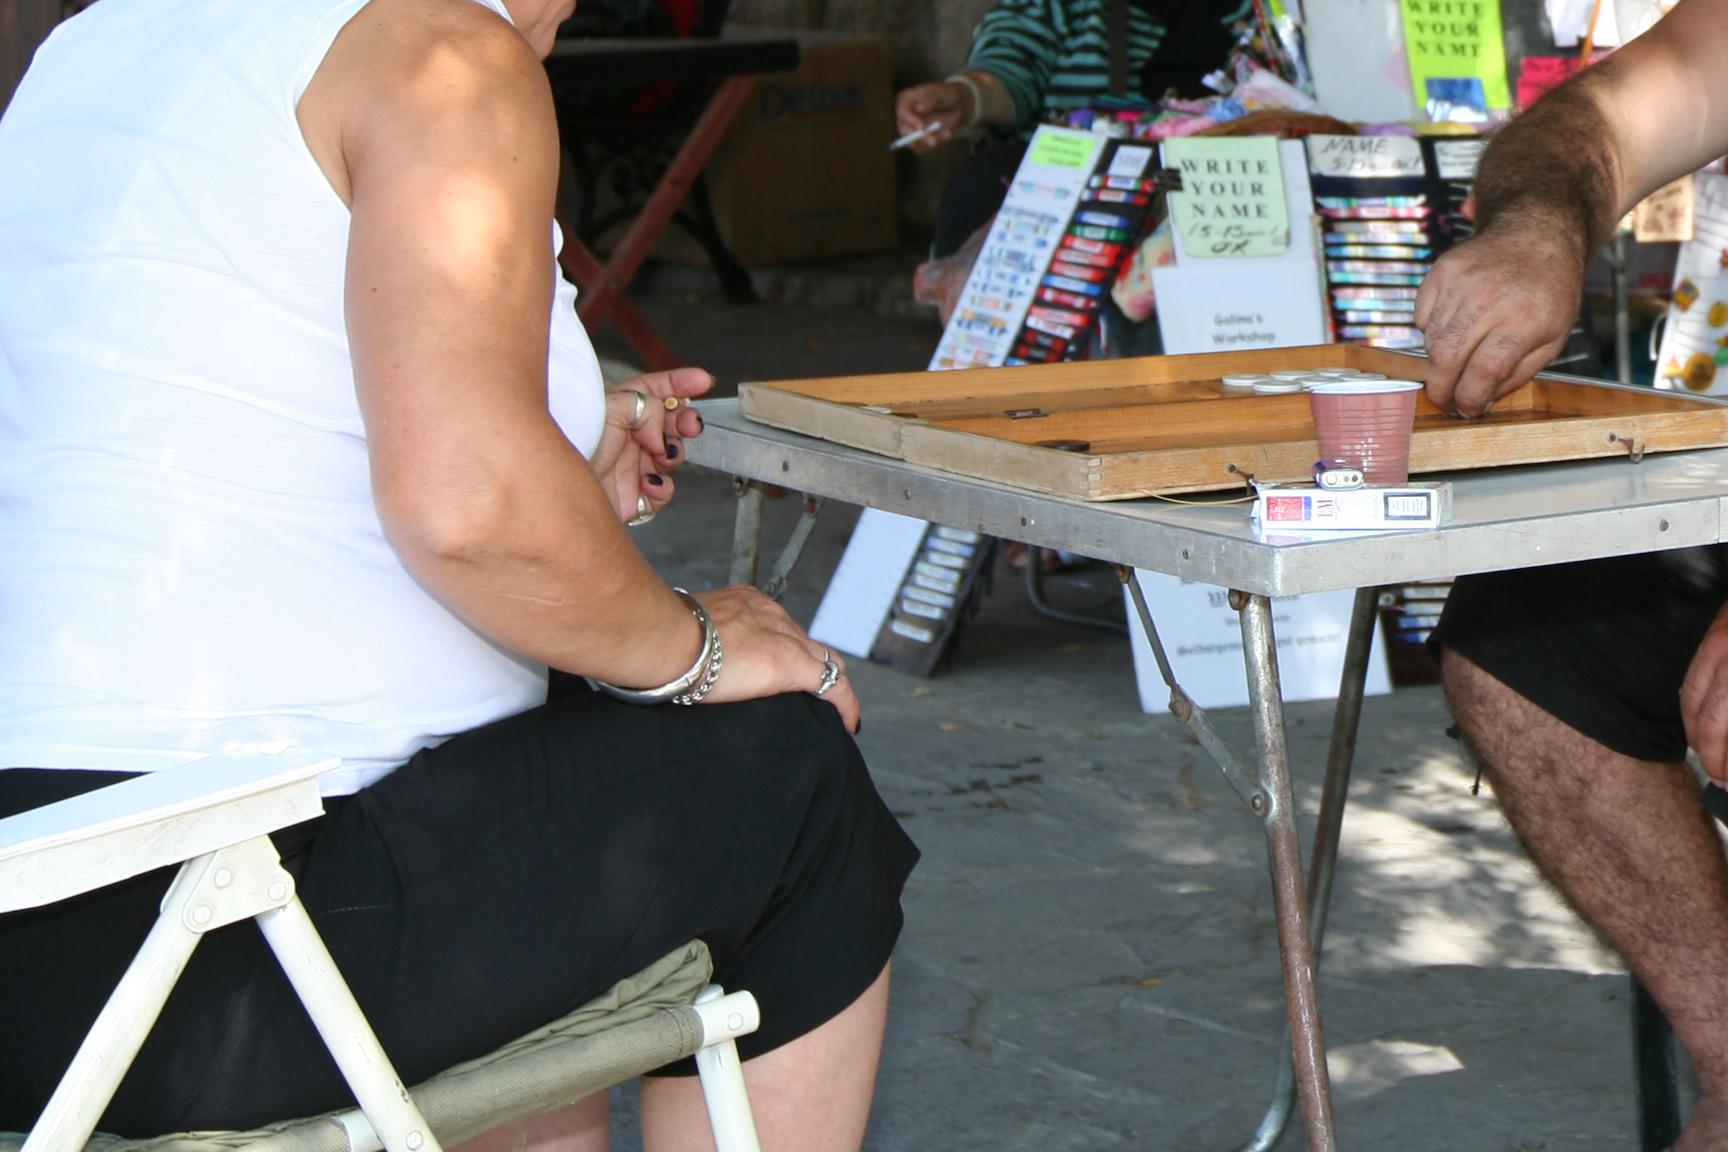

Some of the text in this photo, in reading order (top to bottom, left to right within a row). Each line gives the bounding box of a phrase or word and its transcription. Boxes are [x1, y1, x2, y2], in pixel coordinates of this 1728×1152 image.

[1406, 0, 1486, 16] WRITE
[1413, 21, 1482, 37] YOUR
[1416, 42, 1483, 58] NAME
[1321, 137, 1388, 155] NAME
[1180, 159, 1271, 175] WRITE
[1189, 180, 1265, 197] YOUR
[1191, 202, 1269, 219] NAME
[1214, 311, 1264, 327] Galina's
[1211, 332, 1276, 347] Workshop
